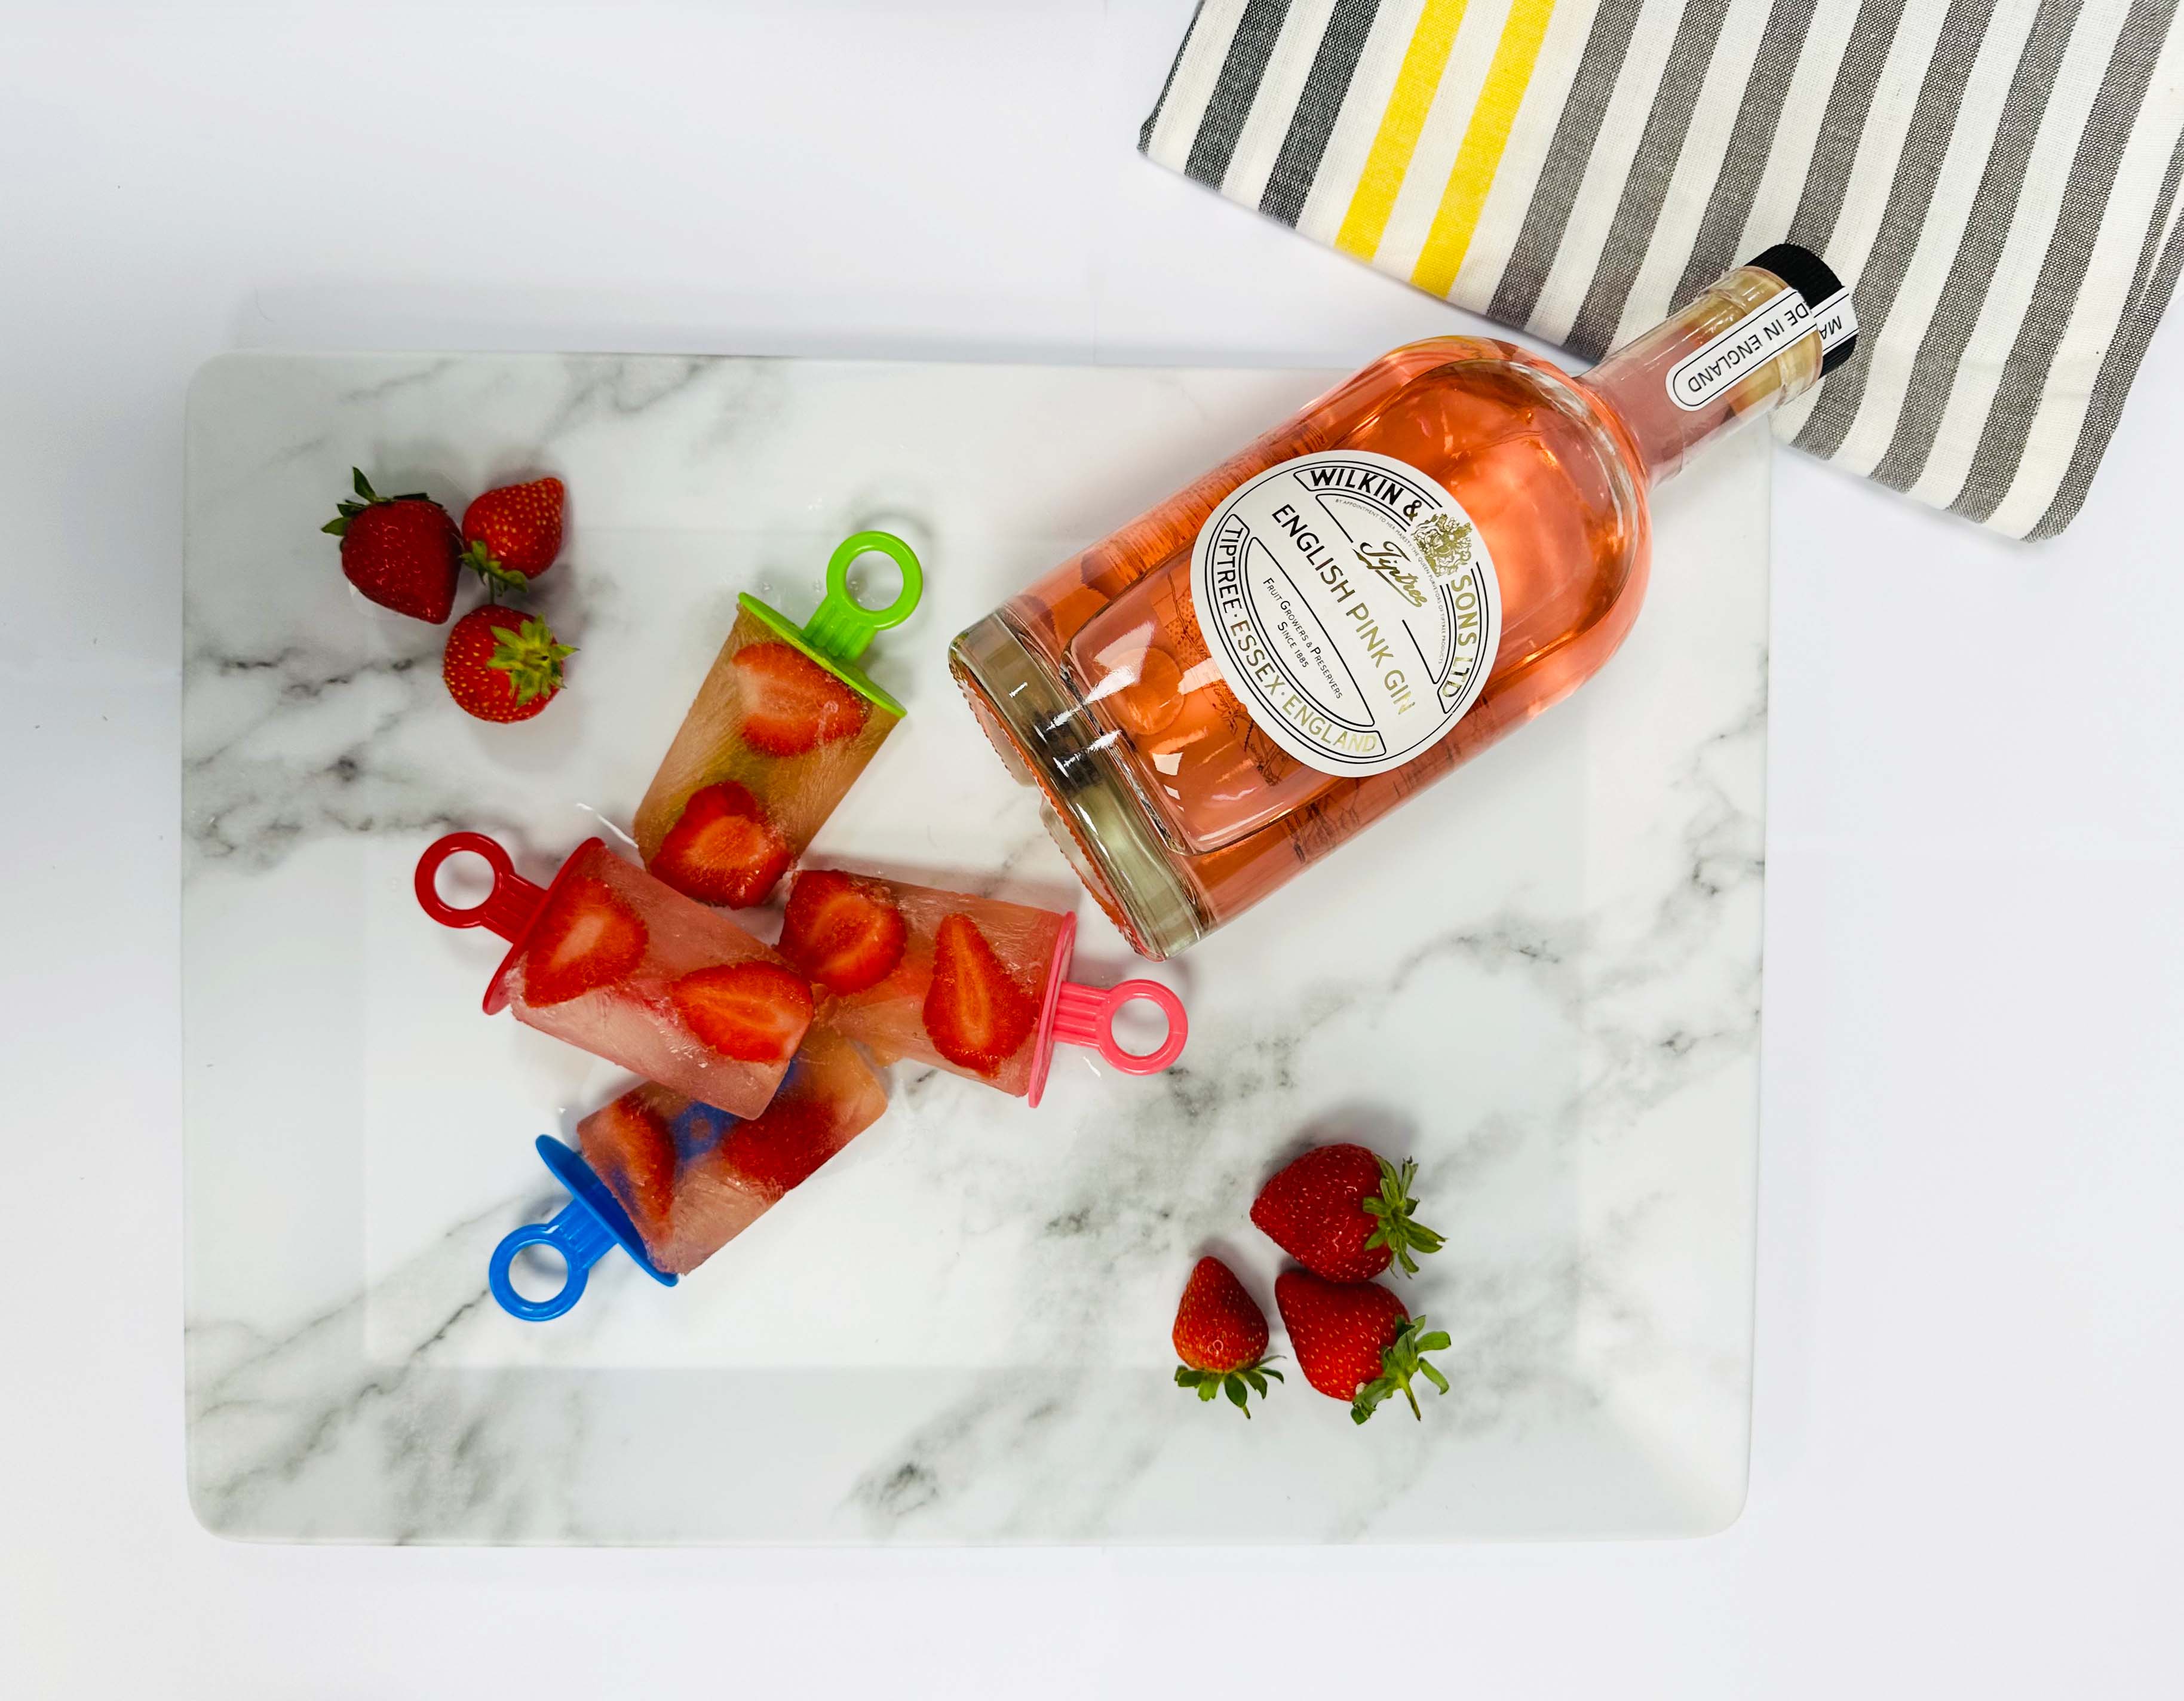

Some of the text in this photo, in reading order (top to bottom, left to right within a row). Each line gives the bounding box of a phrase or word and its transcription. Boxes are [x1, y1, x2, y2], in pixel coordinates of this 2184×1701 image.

[1763, 319, 1785, 340] IN
[1688, 334, 1763, 392] ENGLAND
[1217, 527, 1244, 614] TIPTREE
[1310, 468, 1479, 698] WILKIN & SONS LTD
[1343, 501, 1379, 518] APPOINTMENT
[1386, 521, 1395, 530] HER
[1395, 529, 1413, 548] MAJESTY
[1411, 546, 1420, 557] THE
[1418, 557, 1431, 575] QUEEN
[1428, 574, 1442, 605] PURVEYORS
[1438, 635, 1446, 664] PRODUCTS
[1351, 541, 1428, 607] Tiptree
[1272, 503, 1416, 715] ENGLISH PINK GIN
[1229, 619, 1286, 696] ESSEX
[1295, 649, 1309, 668] 1885
[1306, 640, 1314, 649] &
[1282, 694, 1378, 753] ENGLAND
